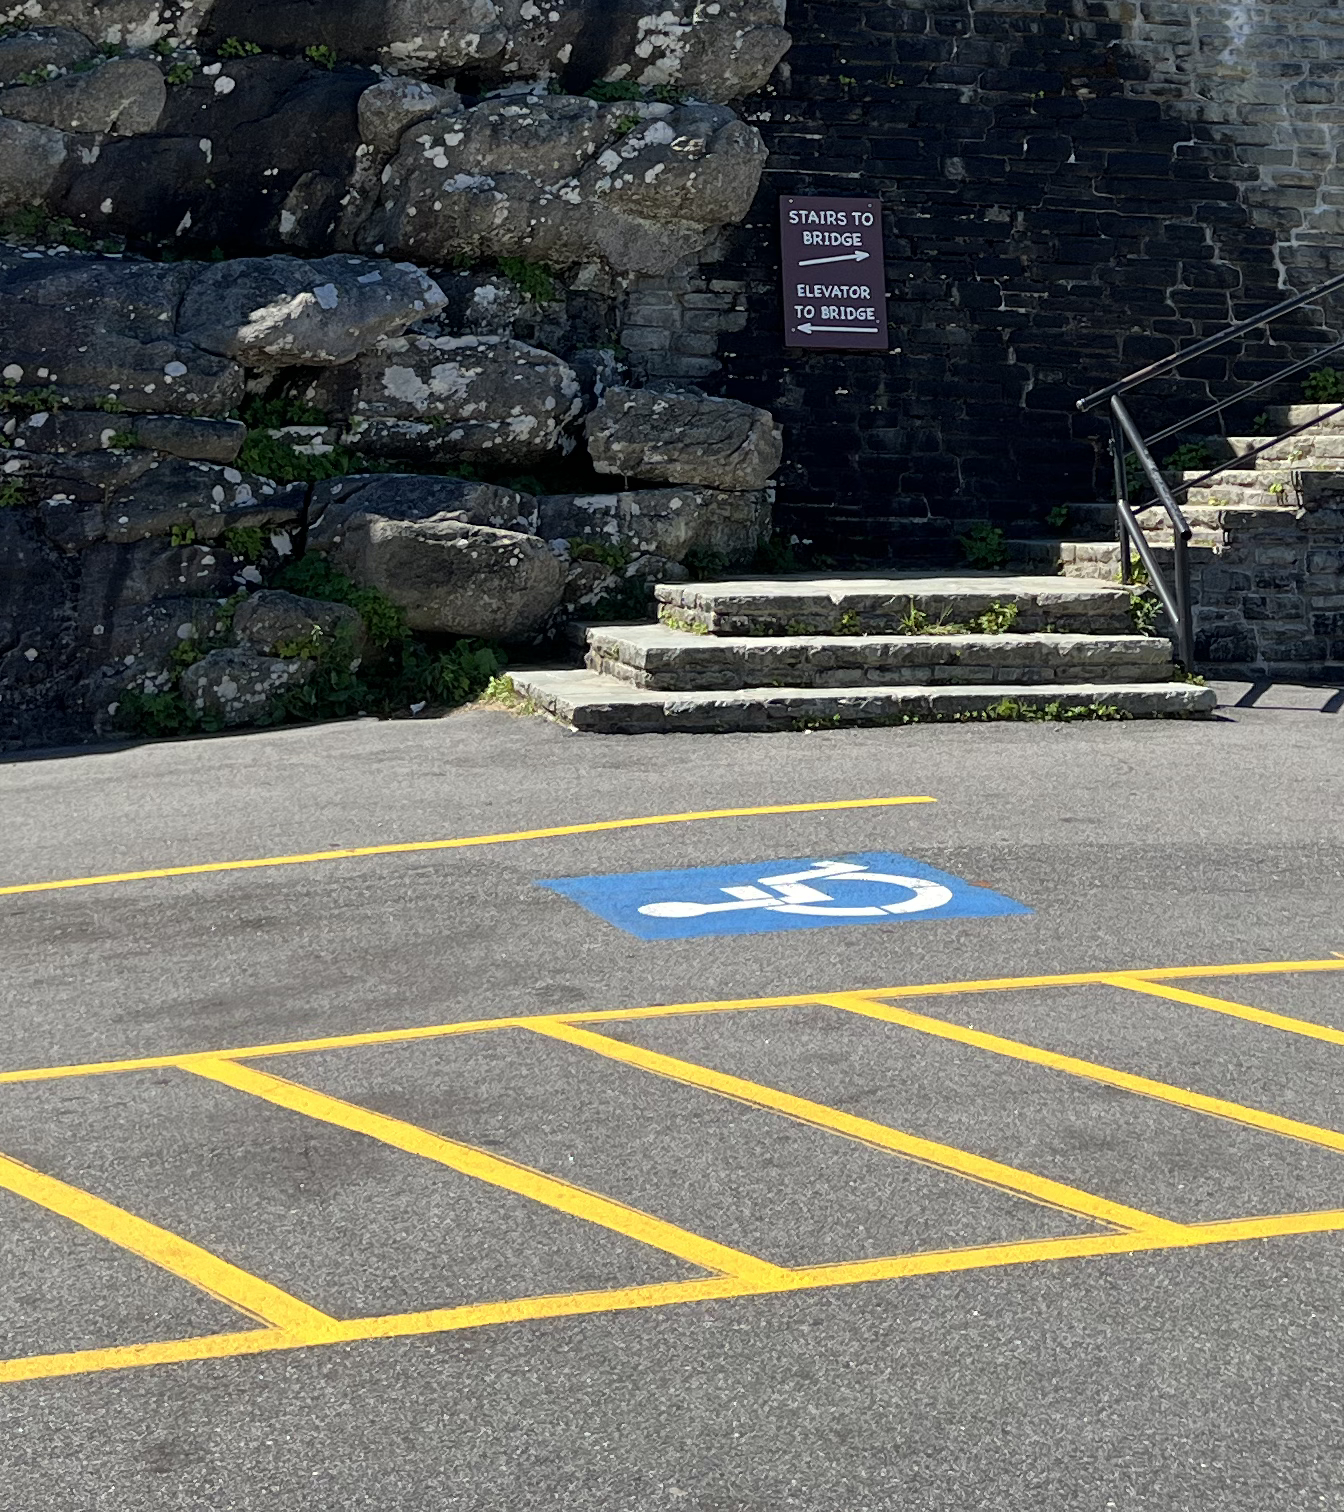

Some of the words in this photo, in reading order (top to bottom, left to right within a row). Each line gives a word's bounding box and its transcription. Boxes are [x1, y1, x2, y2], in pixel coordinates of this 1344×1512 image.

[788, 210, 847, 226] STAIRS
[851, 211, 874, 226] TO
[802, 231, 863, 246] BRIDGE
[796, 284, 871, 299] ELEVATOR
[794, 305, 815, 319] TO
[820, 306, 876, 320] BRIDGE
